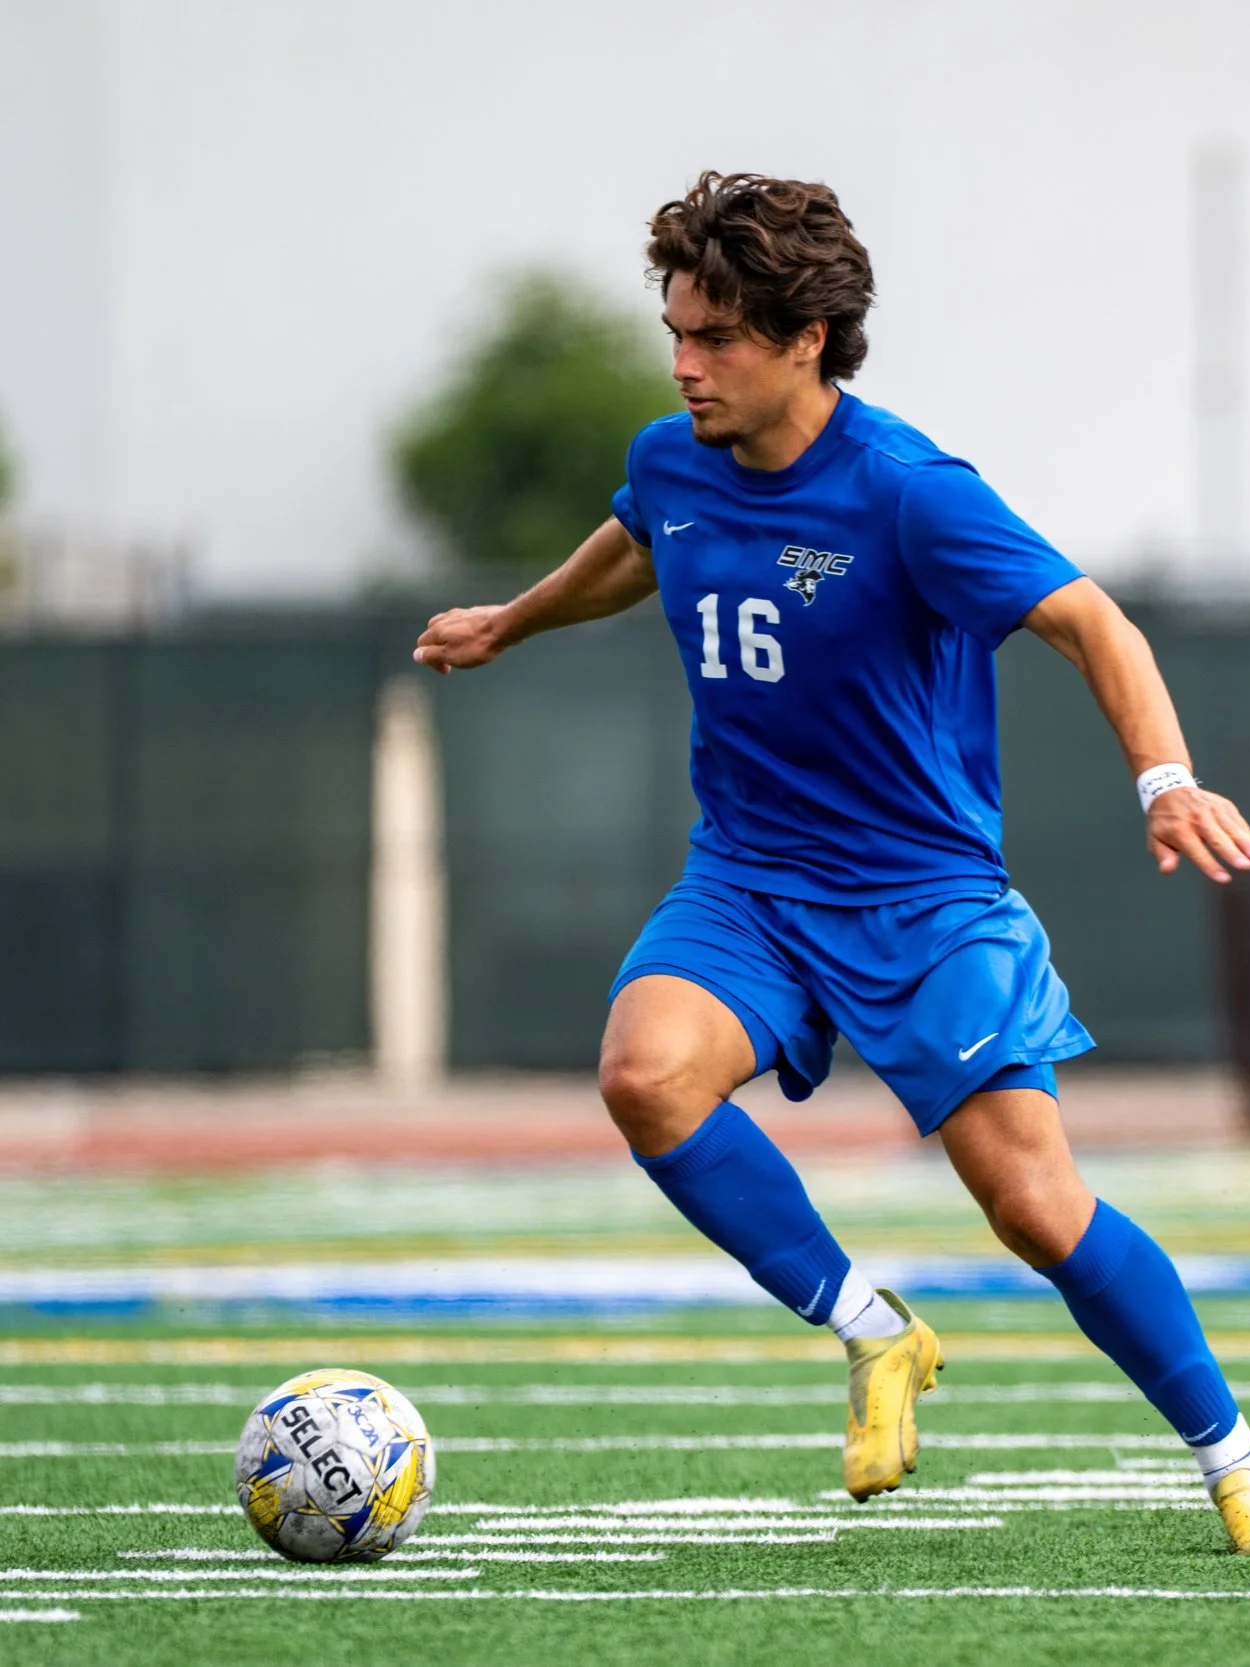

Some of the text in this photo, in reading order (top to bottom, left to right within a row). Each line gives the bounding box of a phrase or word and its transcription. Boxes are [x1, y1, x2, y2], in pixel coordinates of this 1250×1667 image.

[776, 545, 854, 576] SMC
[697, 593, 785, 682] 16
[281, 1406, 362, 1505] SELECT
